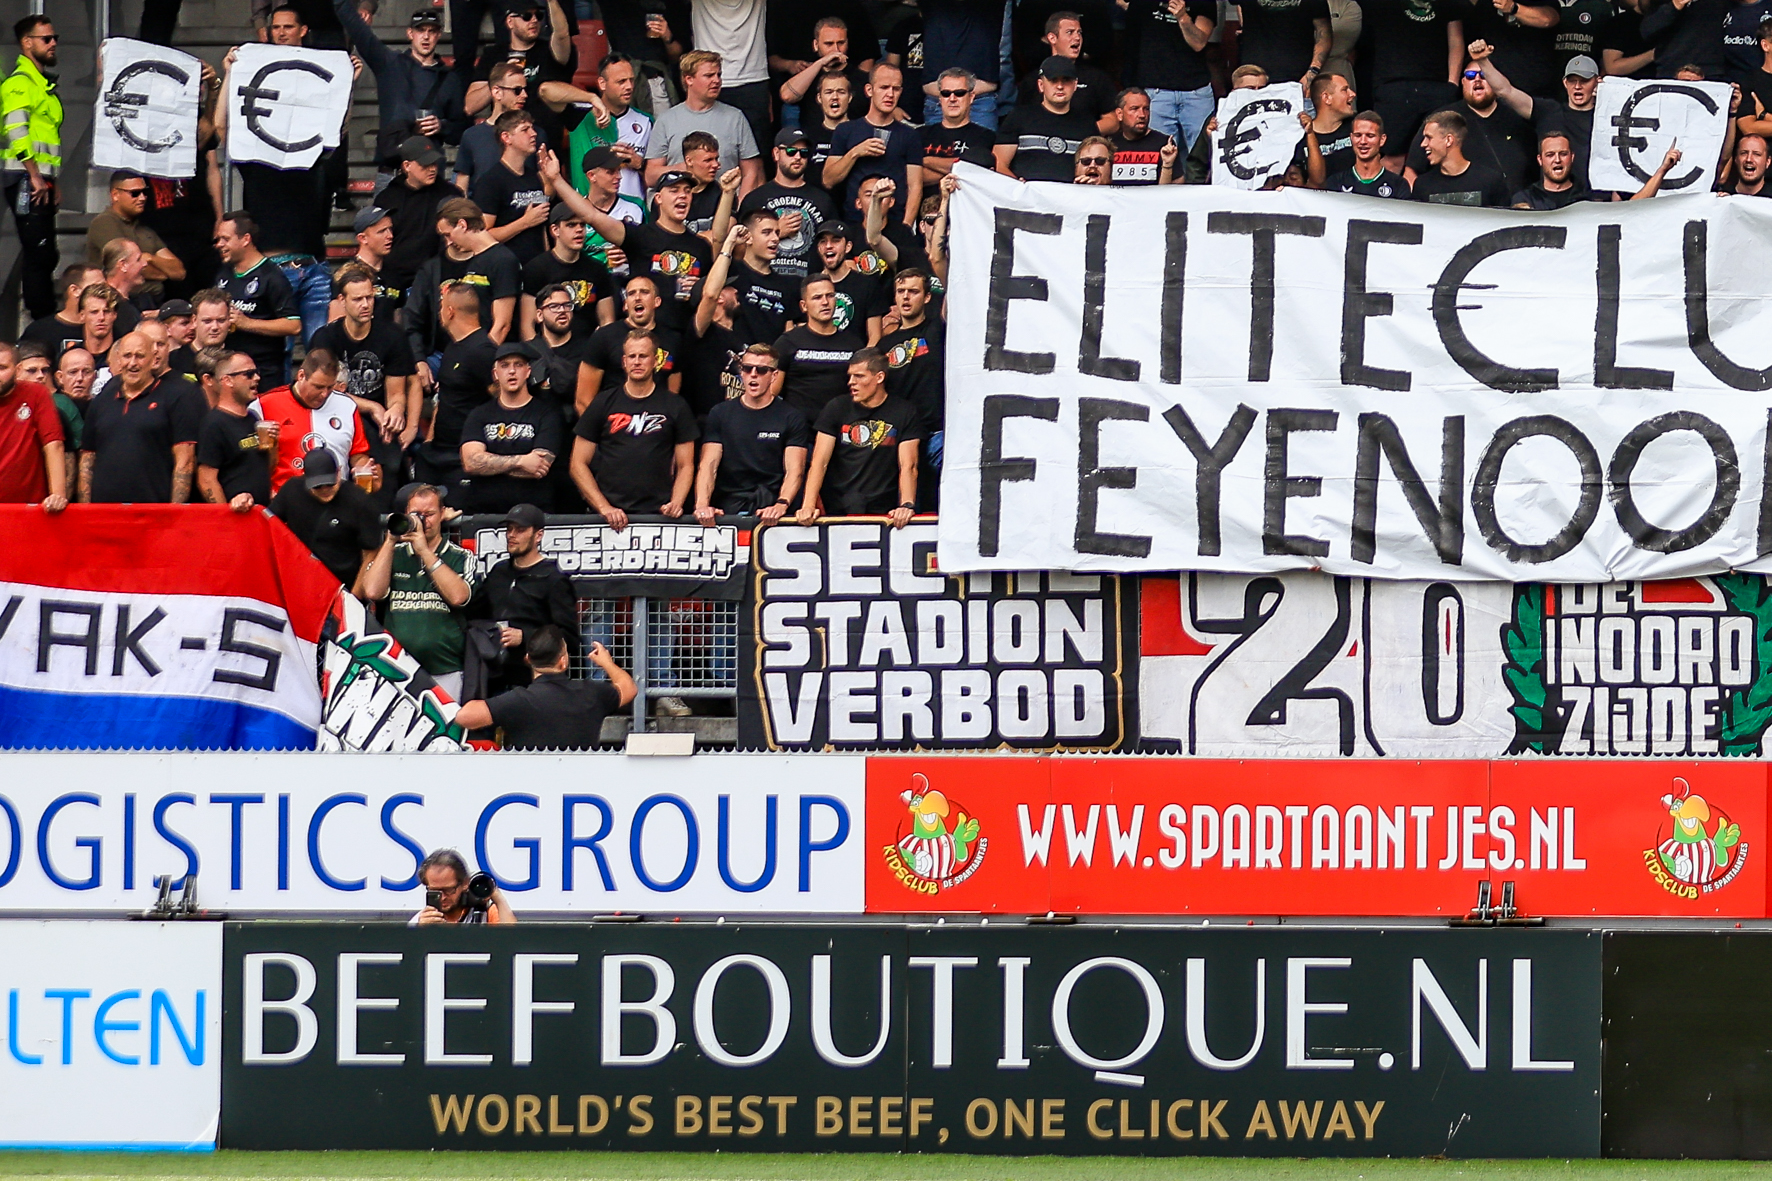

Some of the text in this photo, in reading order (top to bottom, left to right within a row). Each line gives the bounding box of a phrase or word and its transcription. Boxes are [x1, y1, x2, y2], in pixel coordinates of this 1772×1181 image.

[607, 411, 668, 436] DNZ
[765, 599, 1103, 668] STADION
[1560, 615, 1754, 685] NOORD
[765, 669, 1106, 744] VERBOD
[474, 791, 851, 893] GROUP
[883, 844, 938, 895] KIDSCLUB
[1017, 803, 1587, 871] WWW.SPARTAANTJES.NL
[1643, 848, 1698, 899] KIDSCLUB
[241, 951, 1575, 1086] BEEFBOUTIQUE.NL
[429, 1094, 1385, 1145] WORLD'S BEST BEEF, ONE CLICK AWAY
